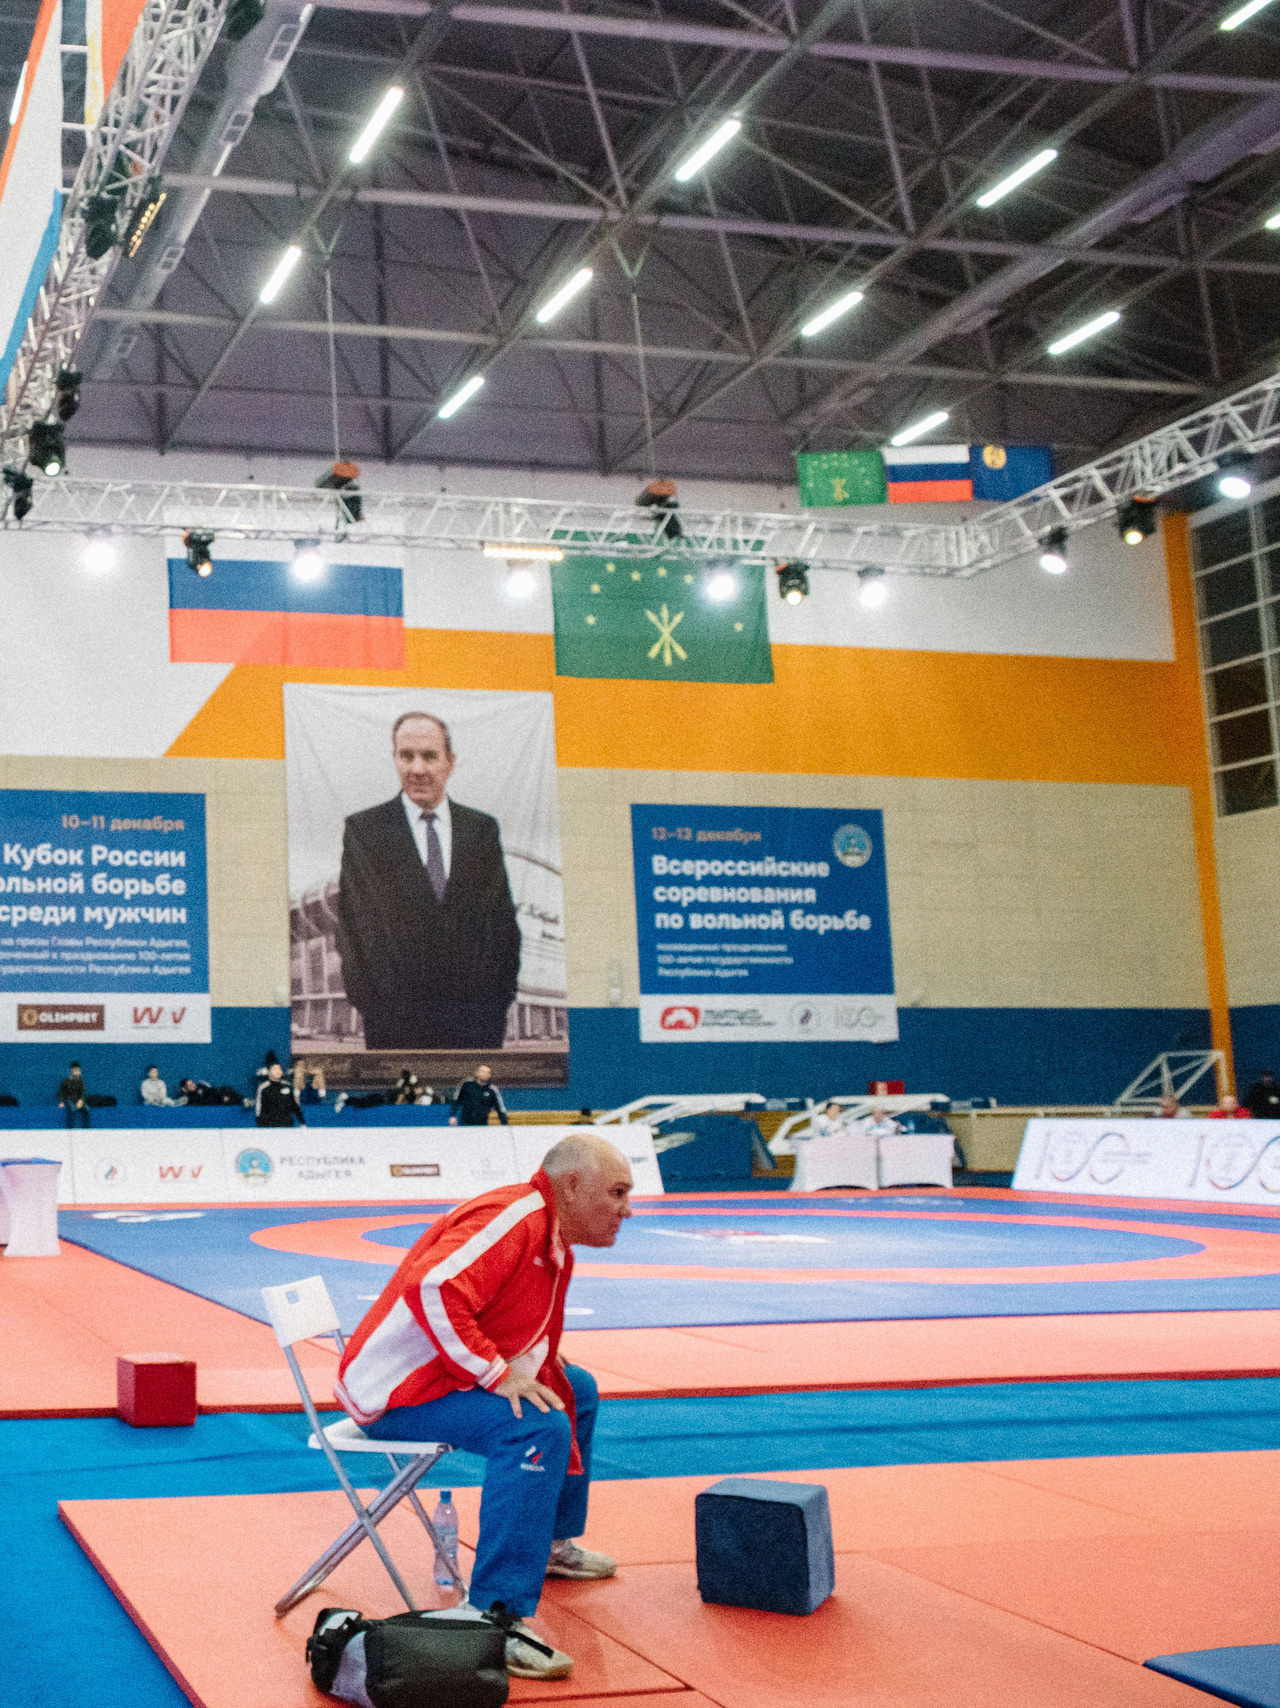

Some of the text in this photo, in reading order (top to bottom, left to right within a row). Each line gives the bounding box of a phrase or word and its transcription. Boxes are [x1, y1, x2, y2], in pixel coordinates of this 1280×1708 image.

[110, 815, 185, 833] декабря
[3, 843, 186, 871] Кубок России
[652, 855, 830, 880] Всероссийские
[92, 873, 187, 899] борьбе
[653, 886, 817, 907] соревнования
[84, 906, 187, 930] мужчин
[655, 909, 872, 935] по вольной борьбе
[279, 1156, 366, 1166] РЕСПУБЛИКА
[297, 1169, 353, 1179] АДЫГЕЯ
